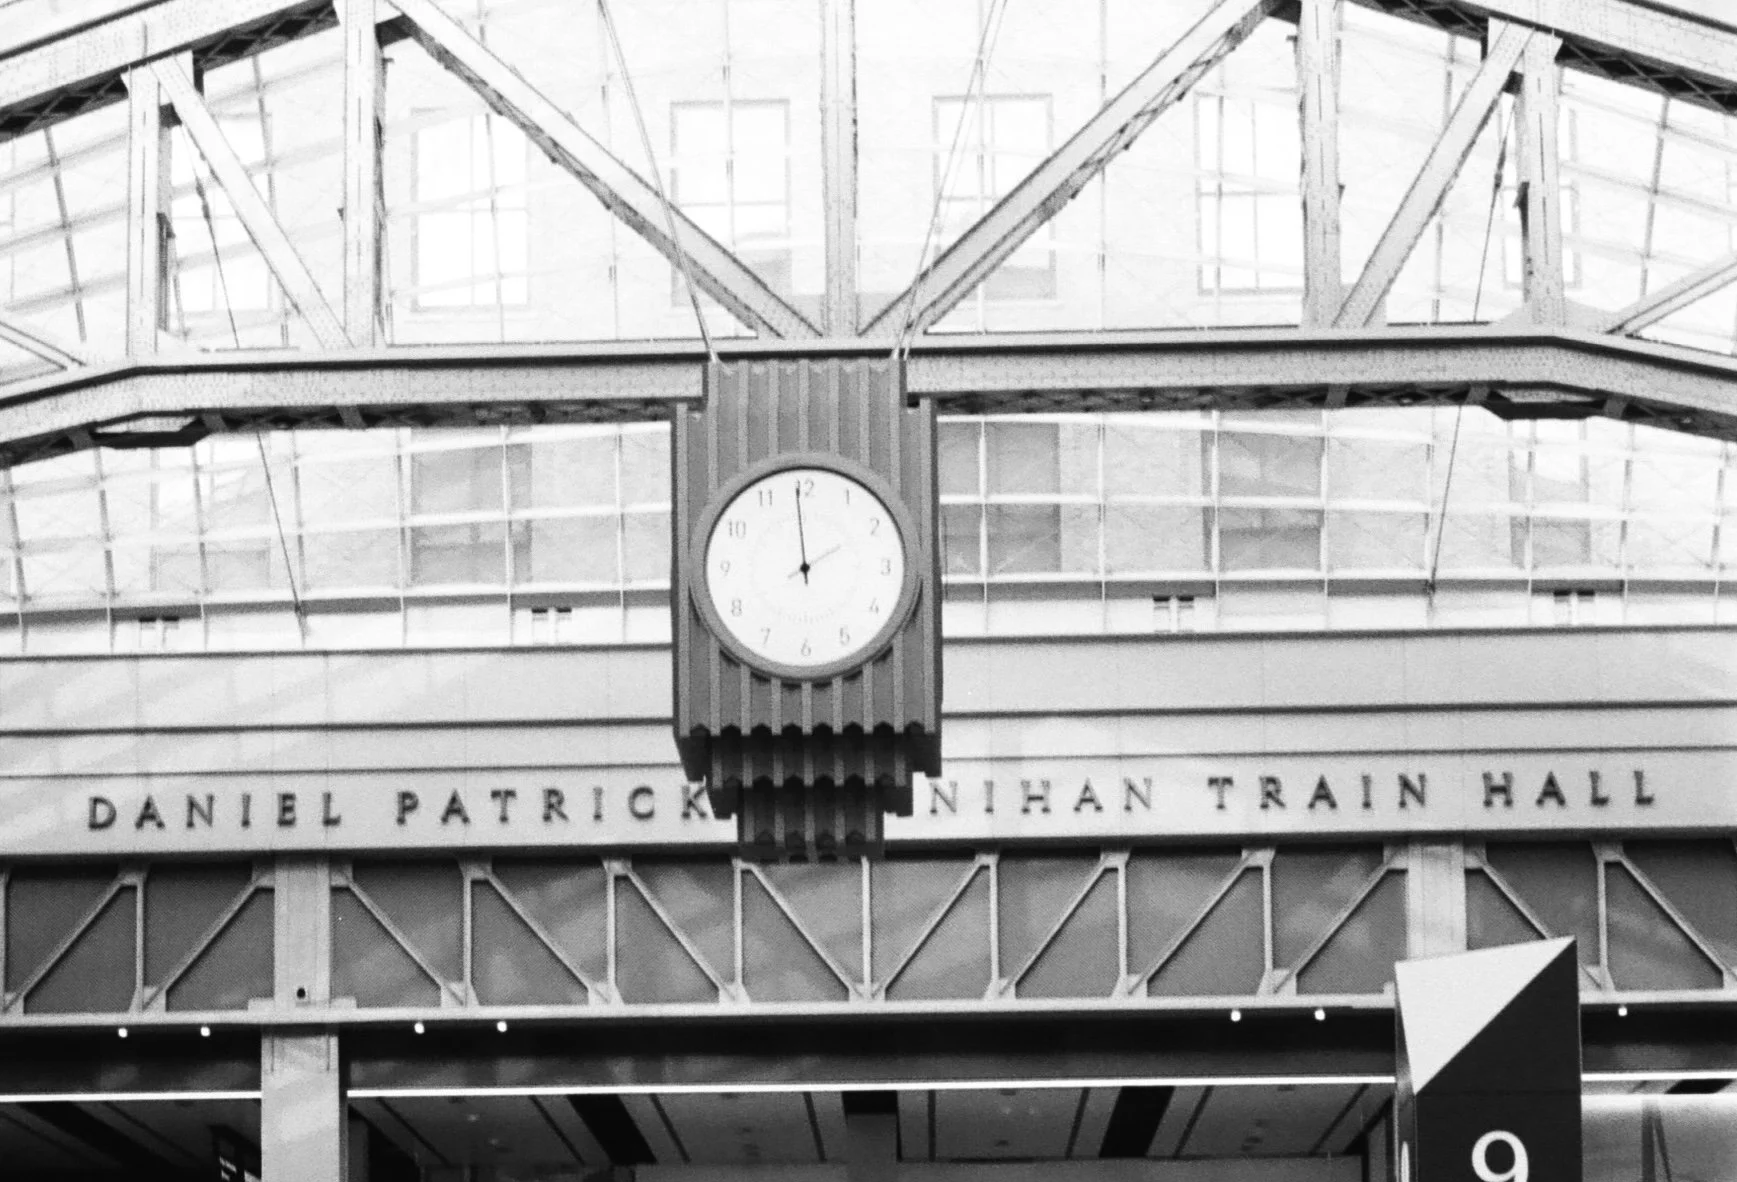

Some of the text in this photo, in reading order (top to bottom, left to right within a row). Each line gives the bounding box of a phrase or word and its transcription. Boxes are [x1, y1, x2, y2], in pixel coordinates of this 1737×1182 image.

[758, 489, 772, 506] 11
[795, 479, 815, 499] 12
[728, 519, 746, 537] 10
[870, 518, 880, 535] 2
[720, 561, 730, 577] 9
[881, 560, 891, 575] 3
[731, 600, 742, 616] 8
[869, 598, 880, 615] 4
[762, 627, 771, 645] 7
[840, 628, 850, 645] 5
[801, 638, 812, 657] 6
[88, 769, 1656, 831] DANIEL PATRICK NIHAN TRAIN HALL
